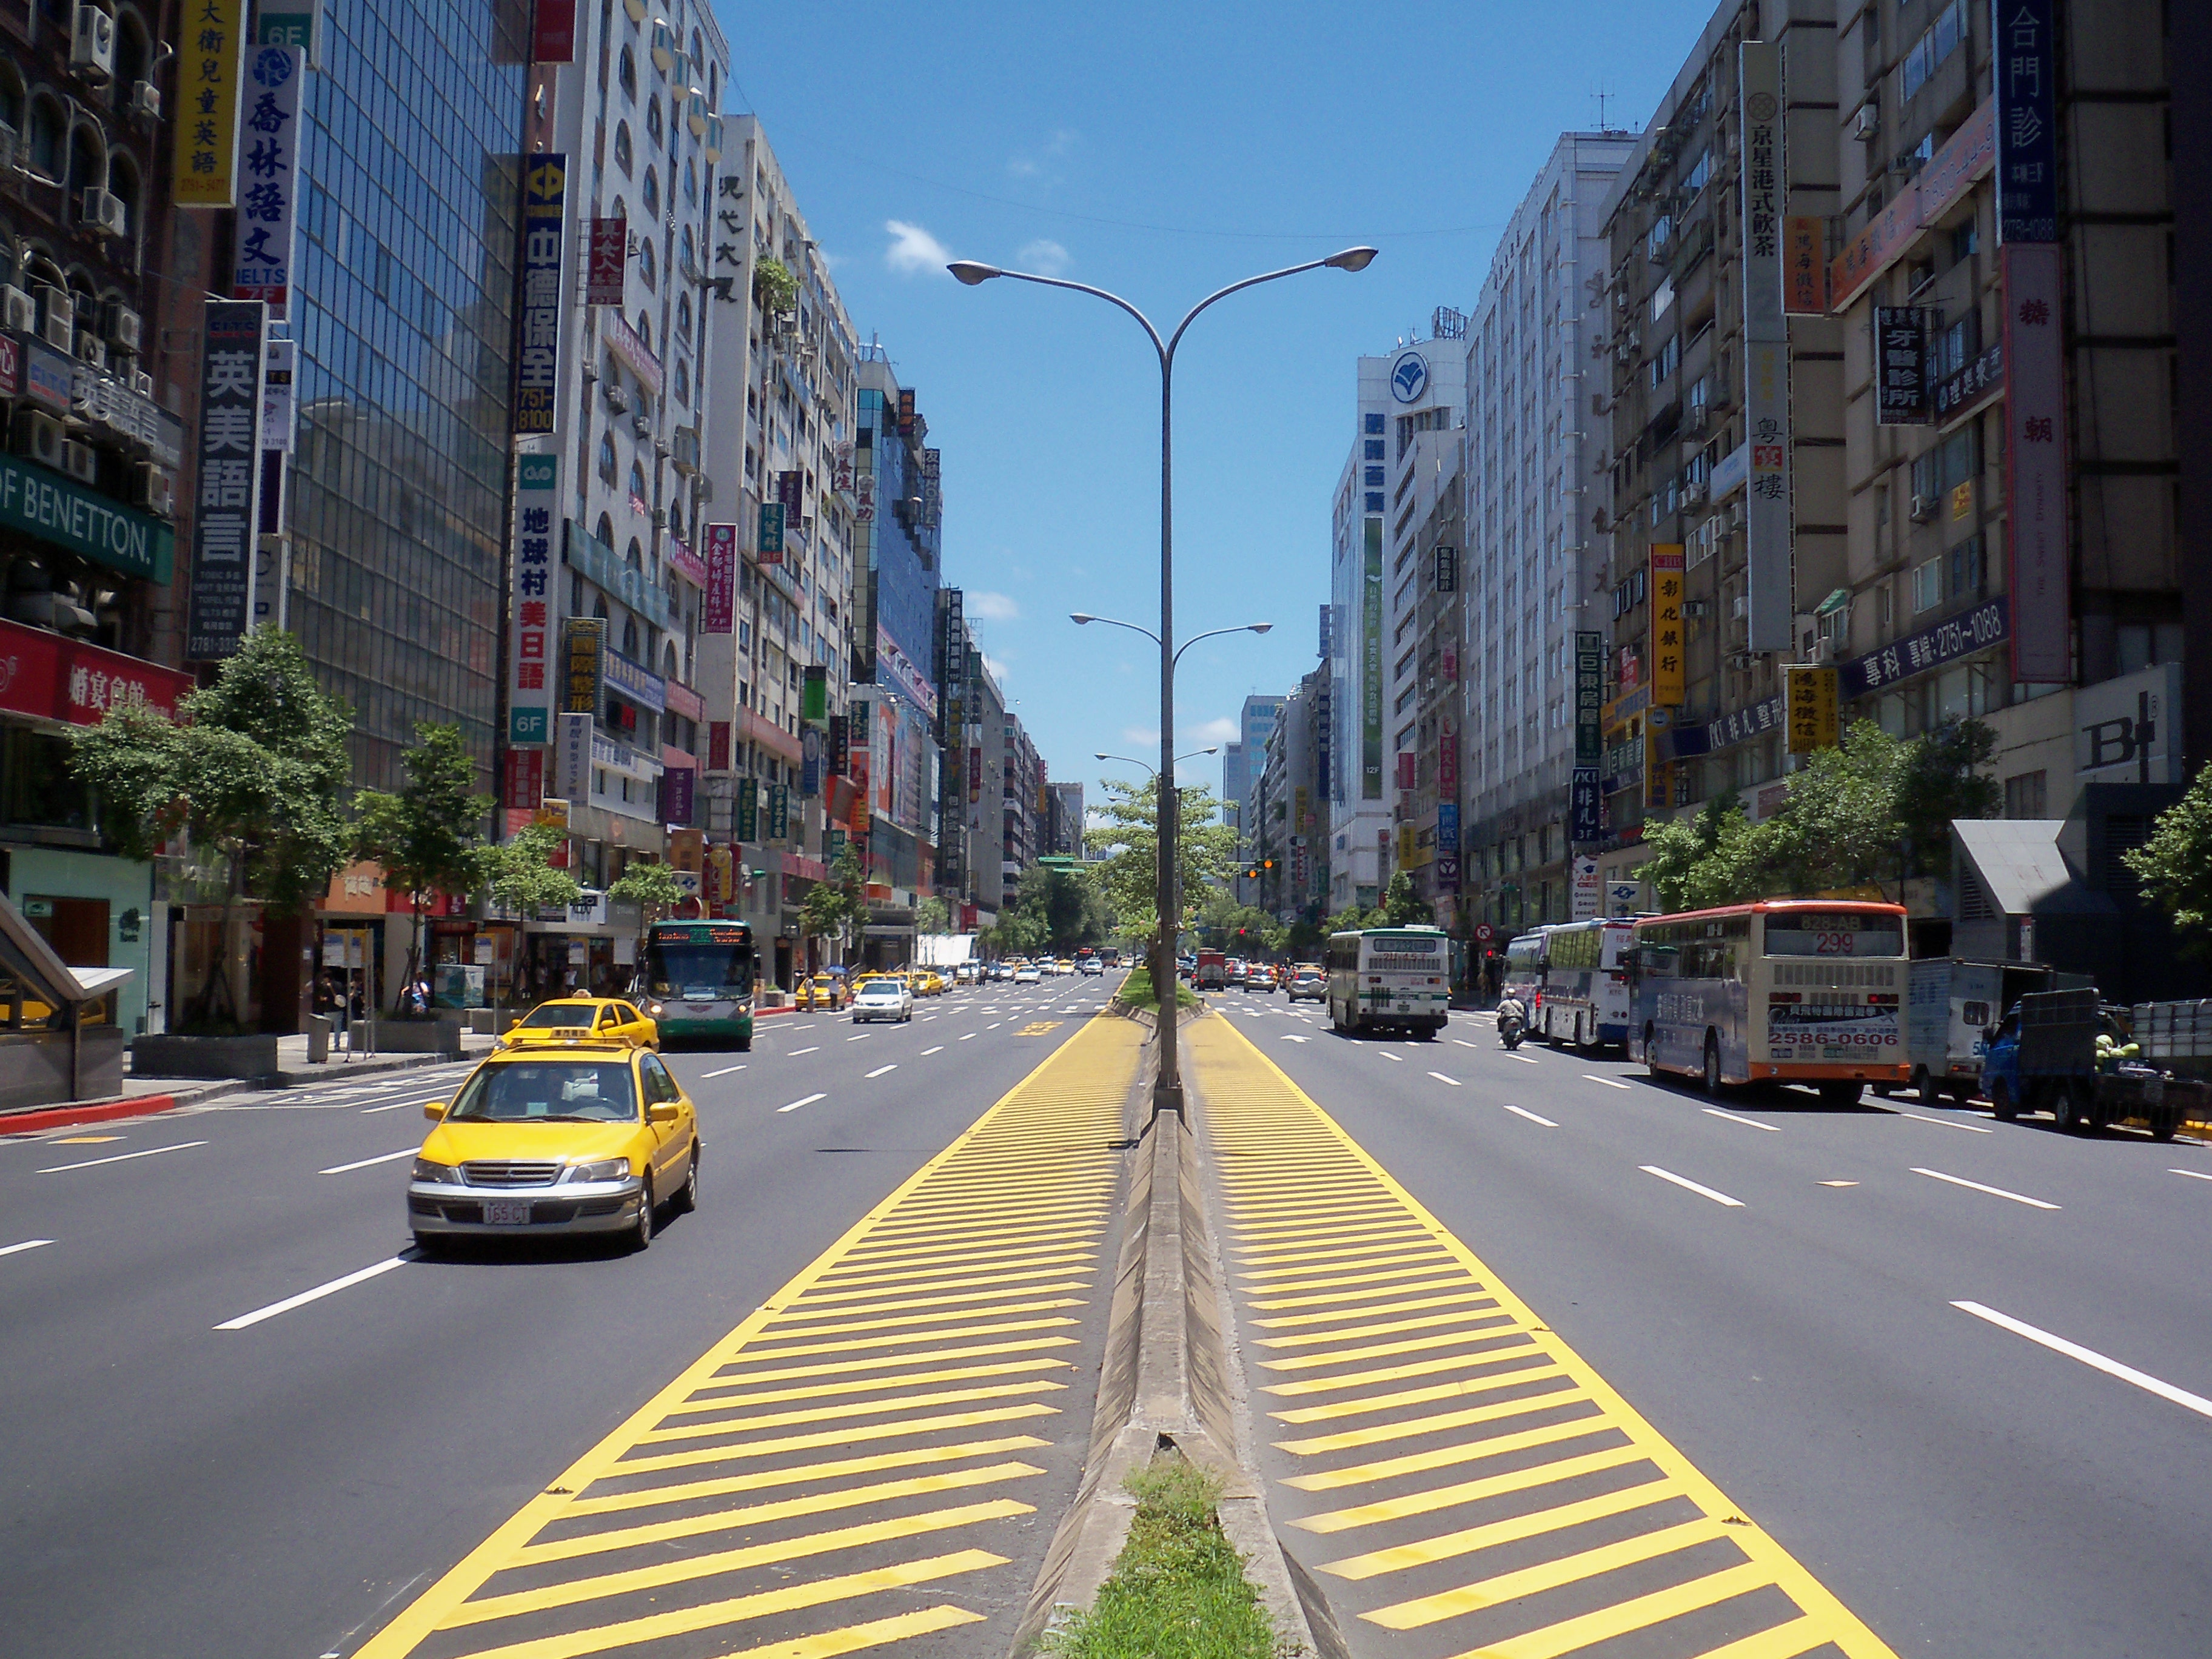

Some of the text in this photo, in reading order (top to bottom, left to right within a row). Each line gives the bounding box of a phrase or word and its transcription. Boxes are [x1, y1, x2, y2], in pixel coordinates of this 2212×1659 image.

[269, 26, 302, 46] 6F
[190, 2, 225, 174] 大衛兒童英語
[2009, 5, 2042, 149] 合門診
[244, 90, 290, 266] 喬林語文
[1751, 124, 1775, 257] 京星港式飲茶
[236, 269, 286, 284] IELTS
[521, 227, 560, 387] 中德保全
[1886, 329, 1919, 407] 牙醫診所
[200, 349, 255, 563] 英美語言
[0, 468, 18, 509] F
[518, 507, 550, 689] 地球村美日語
[1660, 579, 1678, 672] 彰化銀行
[1863, 645, 1902, 687] 專科
[516, 716, 542, 732] 6F
[1366, 766, 1380, 774] 12F
[1578, 788, 1596, 825] 非凡
[1578, 829, 1593, 839] 3F
[1817, 932, 1854, 953] 299
[1768, 1033, 1898, 1045] 2586-0606
